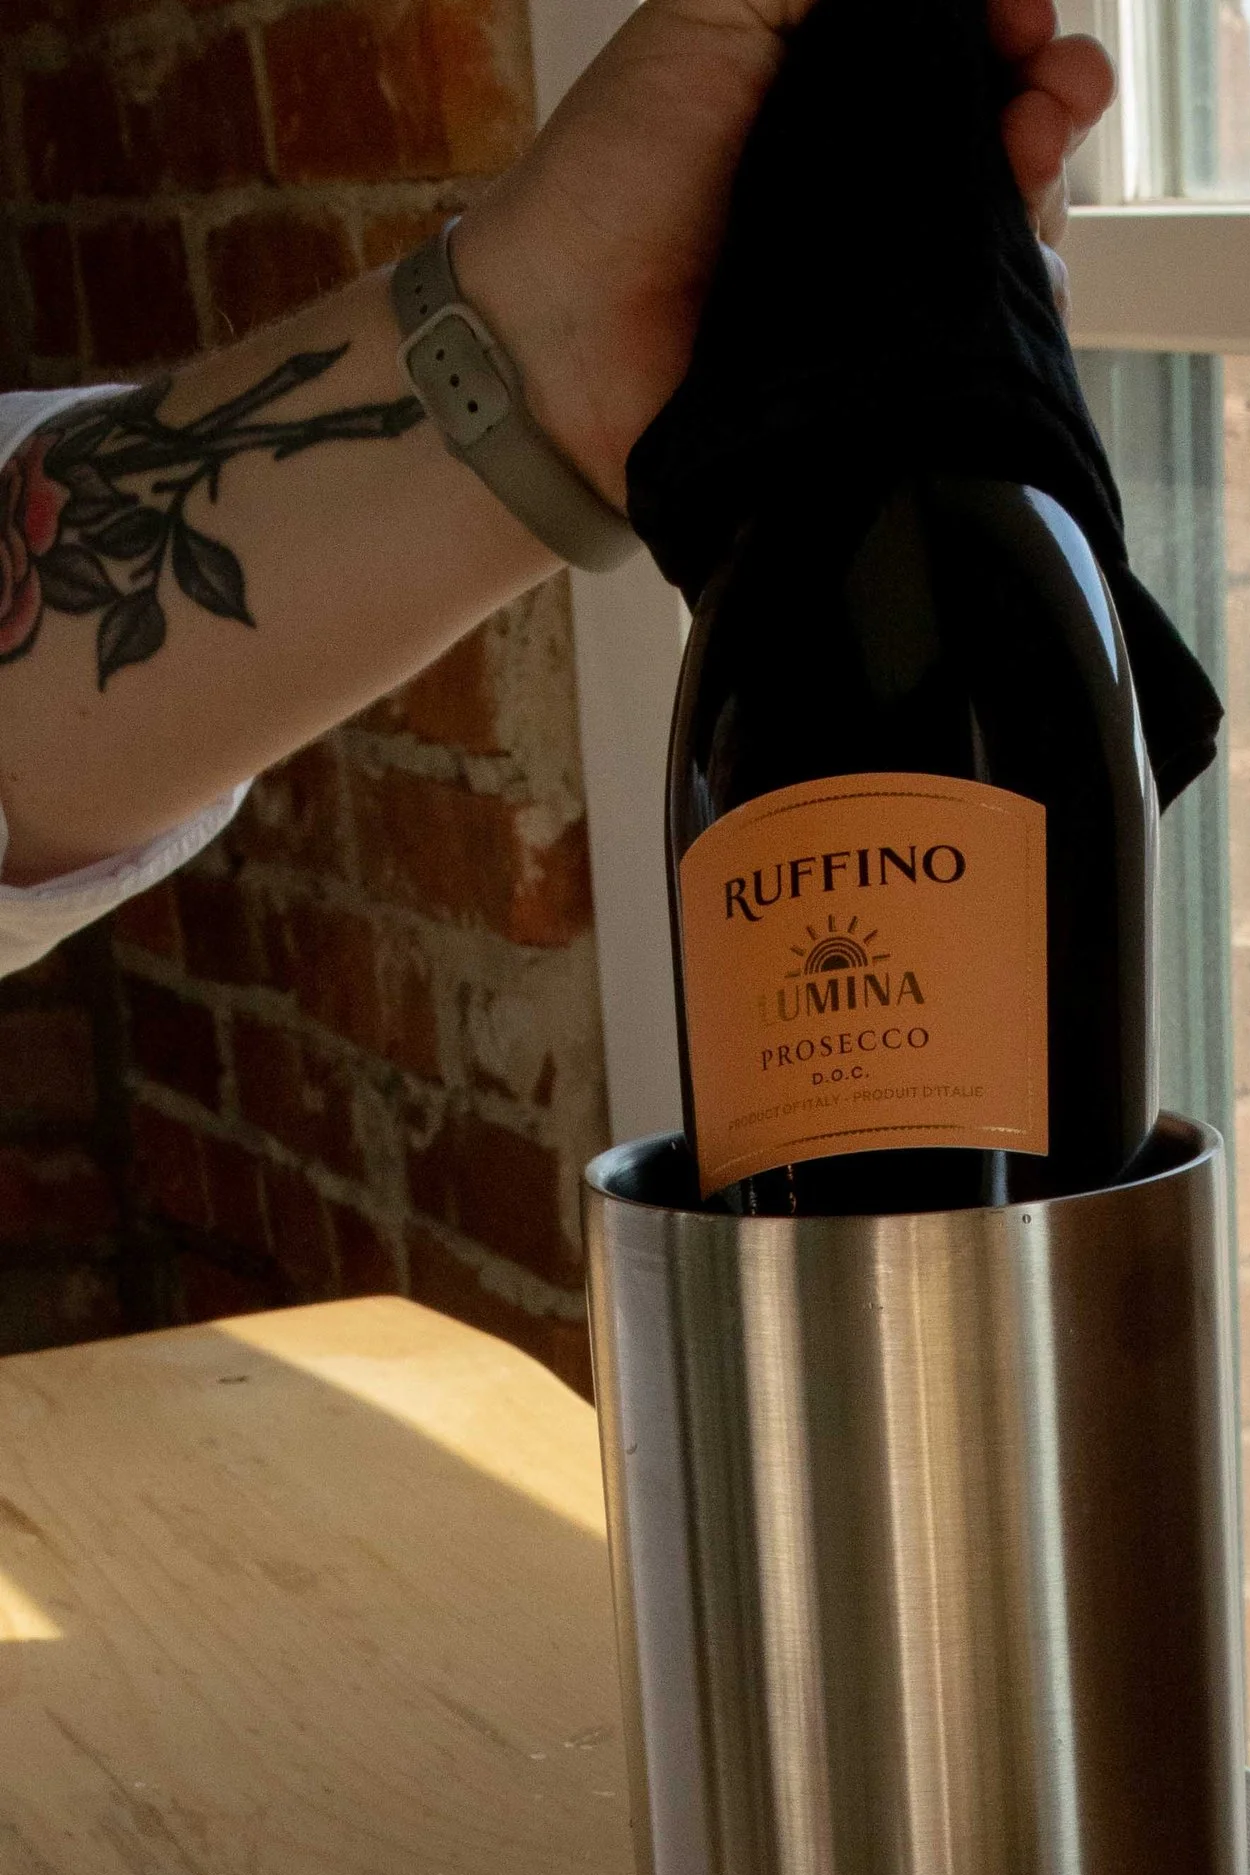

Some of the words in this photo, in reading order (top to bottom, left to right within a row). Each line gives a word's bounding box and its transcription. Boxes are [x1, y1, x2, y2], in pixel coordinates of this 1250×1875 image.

[724, 844, 966, 922] RUFFINO
[753, 971, 925, 1026] LUMINA
[761, 1027, 929, 1071] PROSECCO
[812, 1066, 869, 1085] D.O.C.
[728, 1106, 779, 1131] PRODUCT
[853, 1086, 917, 1103] PRODUIT
